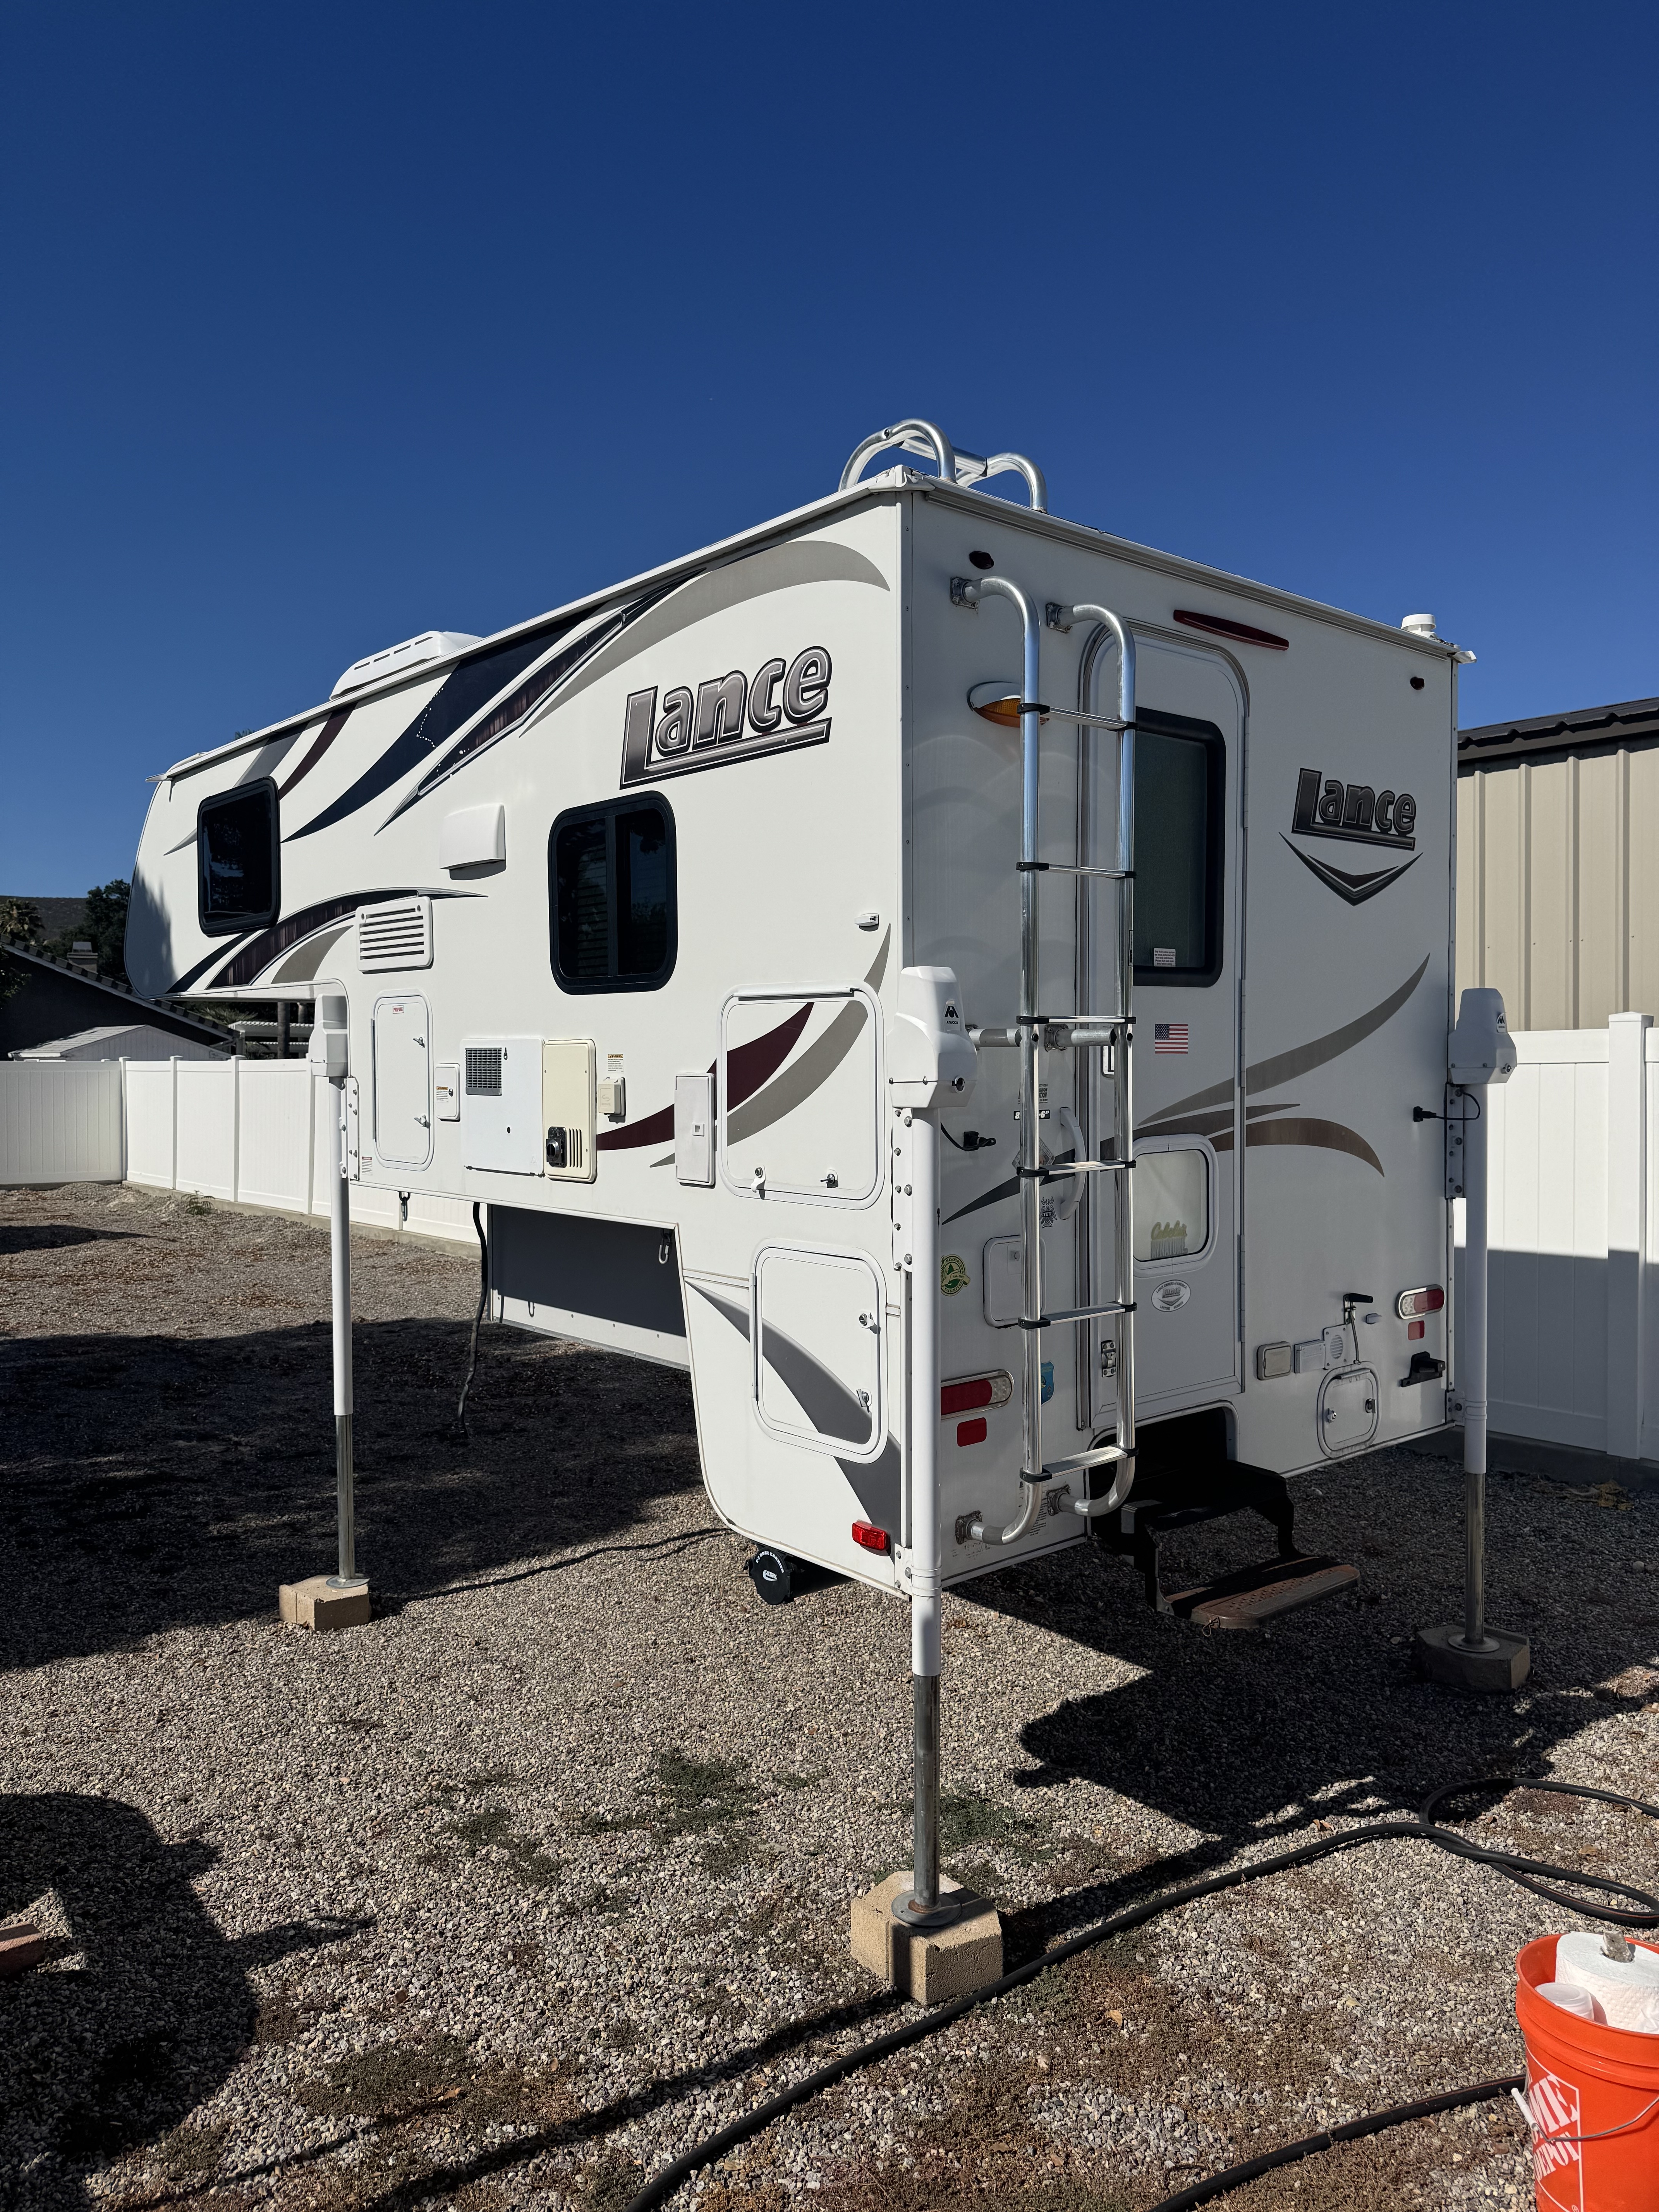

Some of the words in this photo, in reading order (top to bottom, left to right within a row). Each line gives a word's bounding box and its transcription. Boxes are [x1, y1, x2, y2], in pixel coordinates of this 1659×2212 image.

[619, 646, 832, 790] Lance
[1291, 768, 1416, 851] Lance
[769, 1552, 784, 1573] CARRIER
[1533, 2131, 1579, 2181] DEPOT
